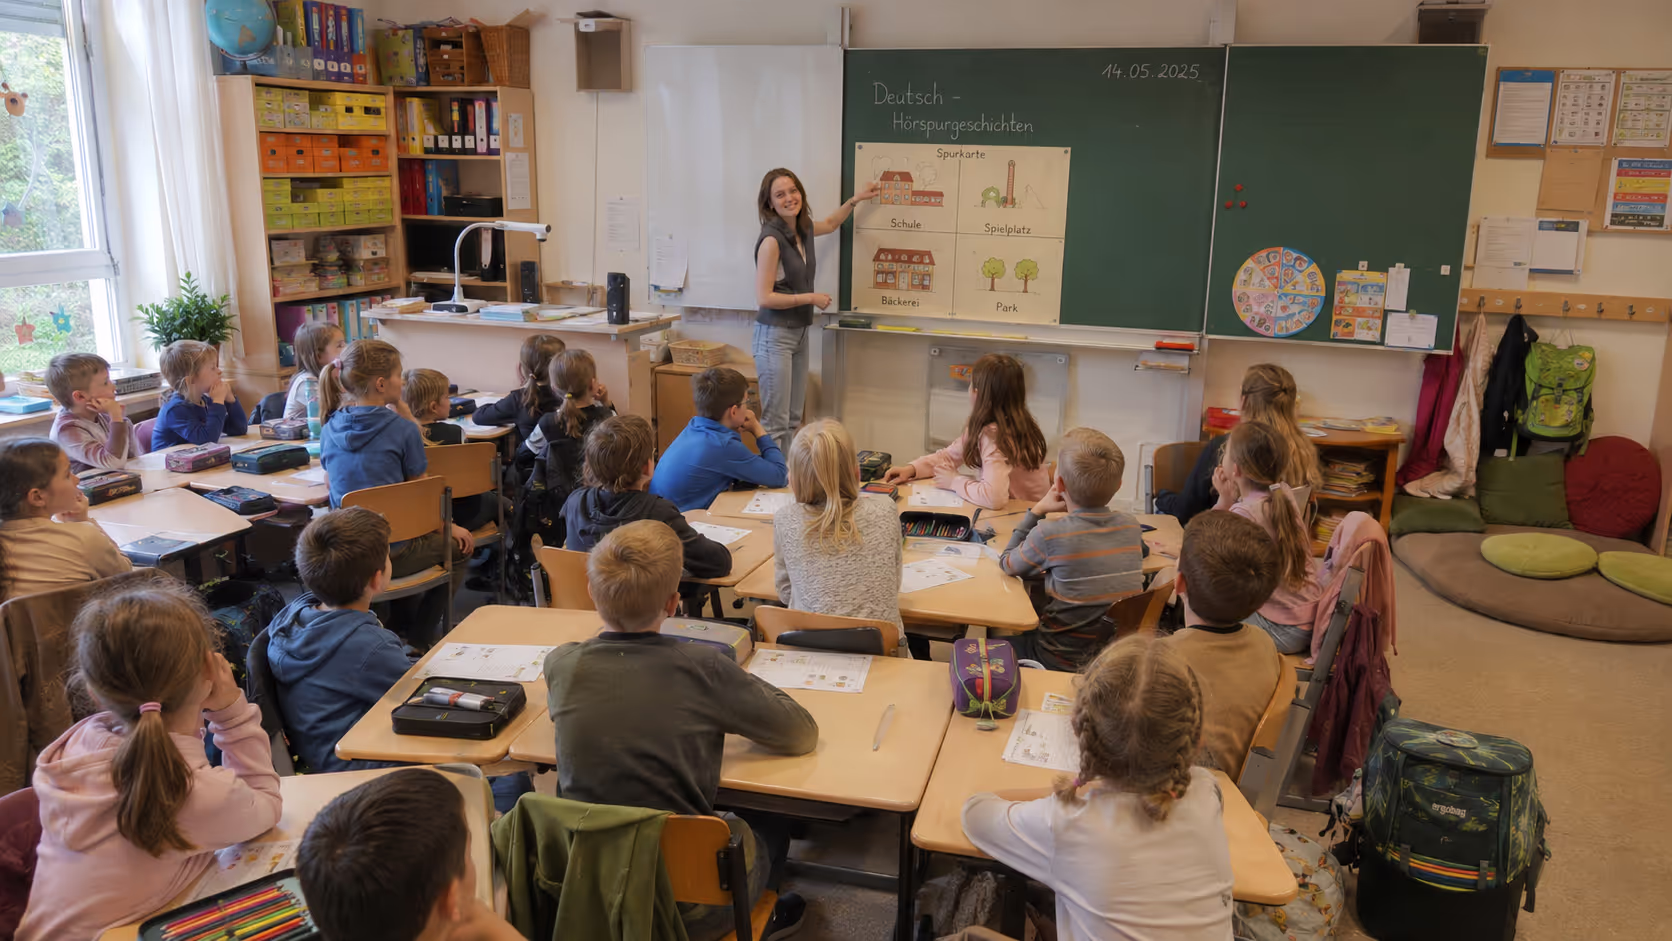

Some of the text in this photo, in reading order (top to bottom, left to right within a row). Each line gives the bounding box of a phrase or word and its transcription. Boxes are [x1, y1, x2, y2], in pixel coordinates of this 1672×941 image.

[1102, 63, 1200, 79] 14.05.2025
[873, 81, 943, 105] Deutsch
[893, 111, 1034, 140] Hörspurgeschichten
[936, 147, 986, 160] Spurkarte
[890, 218, 922, 229] Schule
[984, 223, 1032, 236] Spielplatz
[881, 295, 920, 307] Bäckerei
[996, 301, 1019, 313] Park
[1431, 802, 1467, 818] ergobag
